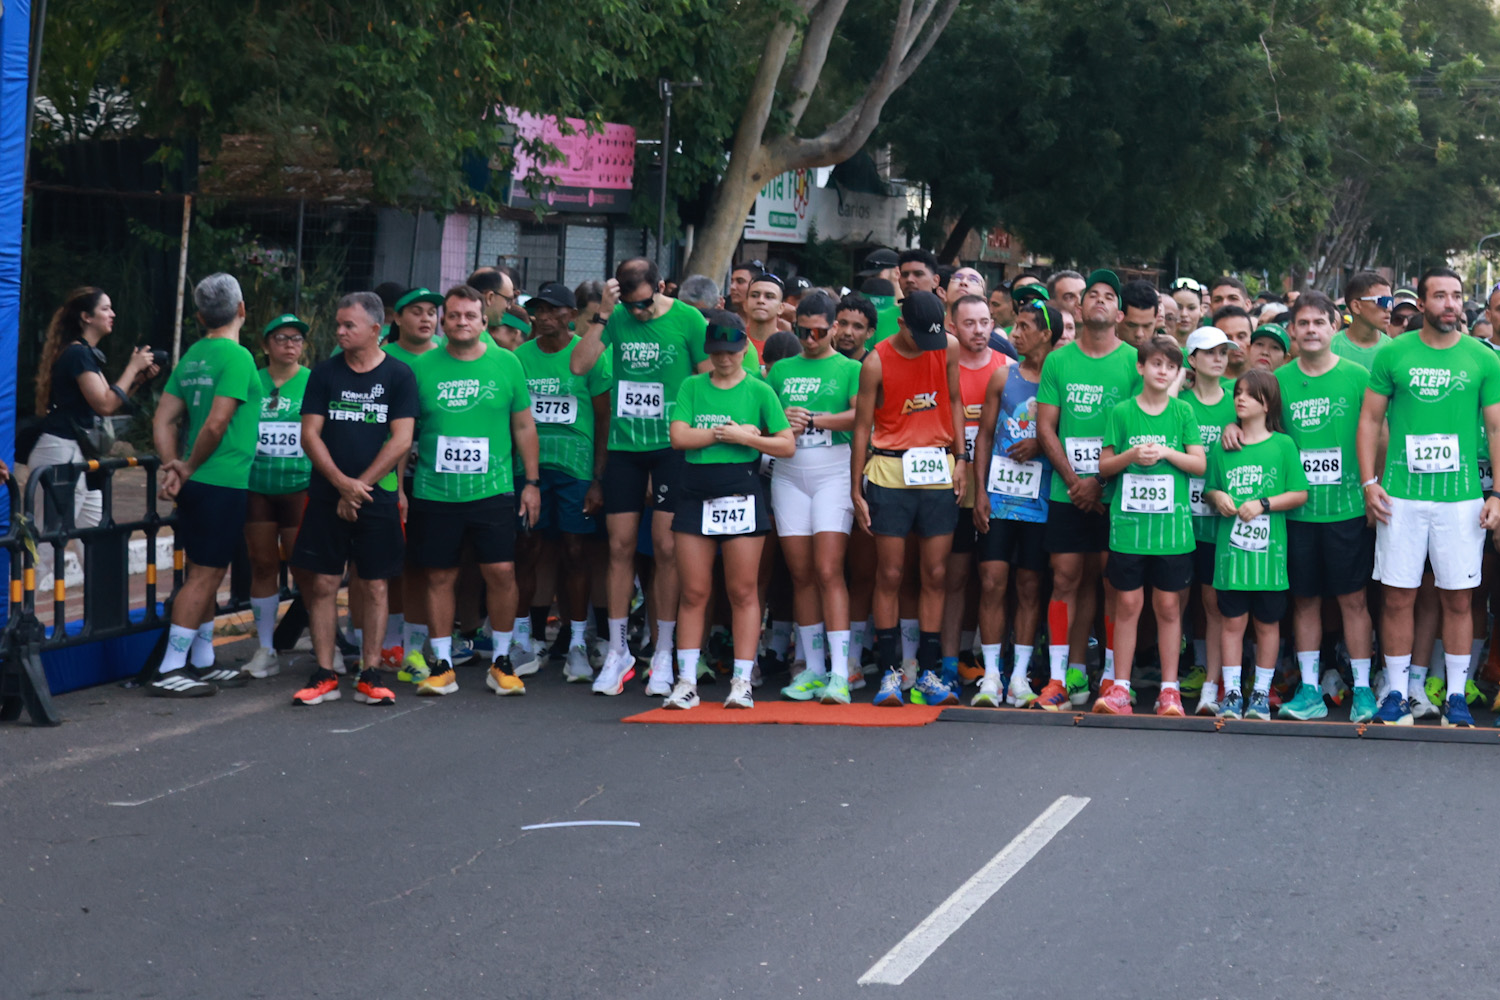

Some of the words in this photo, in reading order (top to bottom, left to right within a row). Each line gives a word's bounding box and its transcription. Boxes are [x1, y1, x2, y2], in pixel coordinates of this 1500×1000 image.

[620, 342, 660, 351] CORRIDA
[621, 350, 659, 362] ALEPI
[1409, 368, 1451, 377] CORRIDA
[437, 379, 480, 390] CORRIDA
[783, 377, 822, 386] CORRIDA
[1066, 383, 1104, 393] CORRIDA
[1409, 375, 1451, 388] ALEPI
[437, 386, 479, 401] ALEPI
[782, 384, 820, 395] ALEPI
[1419, 388, 1439, 396] 2026
[447, 399, 468, 407] 2026
[625, 392, 660, 407] 5246
[789, 394, 808, 402] 2026
[1066, 391, 1103, 405] ALEPI
[1290, 397, 1330, 410] CORRIDA
[535, 401, 570, 415] 5778
[1073, 404, 1092, 413] 2026
[1292, 405, 1330, 420] ALEPI
[695, 414, 731, 423] CORRIDA
[1301, 418, 1321, 427] 2026
[260, 433, 297, 446] 5126
[1128, 434, 1167, 445] CORRIDA
[444, 448, 481, 462] 6123
[1074, 448, 1100, 462] 513
[1415, 446, 1451, 460] 1270
[911, 459, 943, 473] 1294
[1226, 465, 1263, 479] CORRIDA
[1303, 459, 1339, 472] 6268
[997, 468, 1034, 486] 1147
[1228, 473, 1262, 490] ALEPI
[1130, 486, 1167, 501] 1293
[711, 508, 746, 523] 5747
[1234, 522, 1268, 540] 1290
